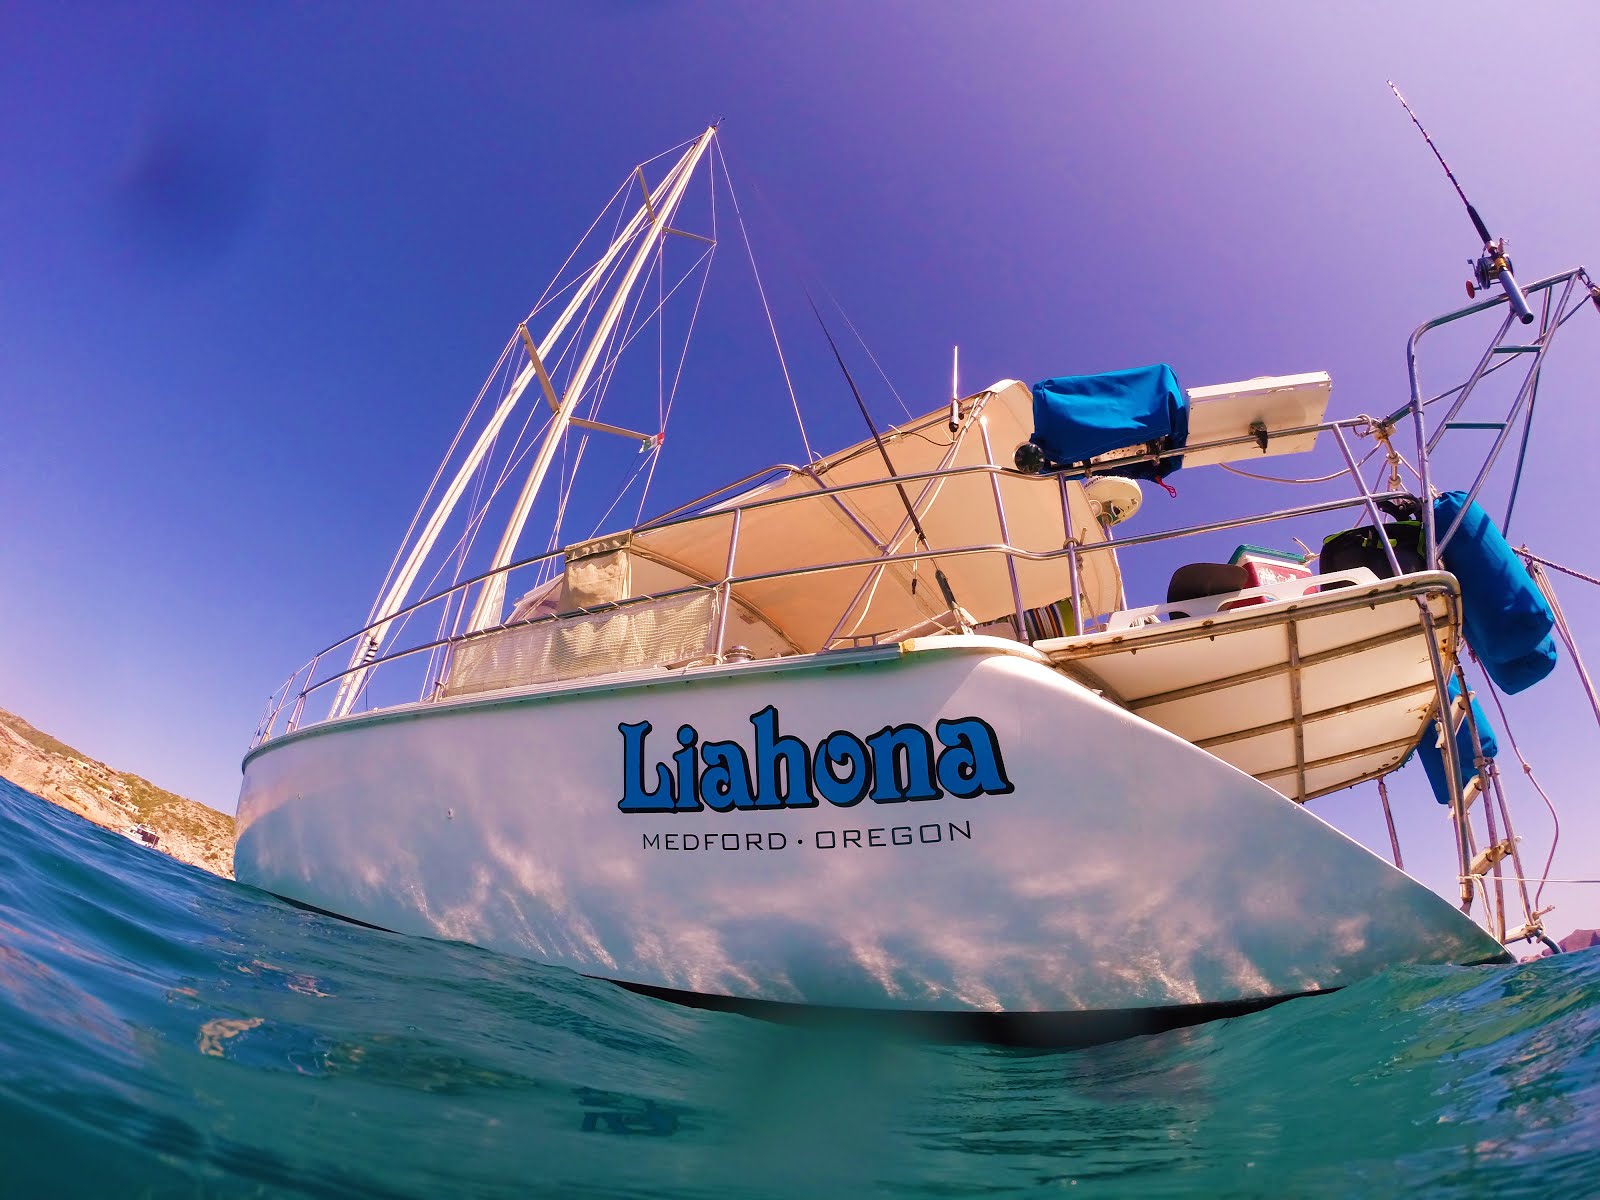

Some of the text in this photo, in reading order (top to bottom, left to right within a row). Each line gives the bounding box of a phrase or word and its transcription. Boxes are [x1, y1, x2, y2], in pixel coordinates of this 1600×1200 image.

[618, 705, 1015, 813] Liahona
[643, 820, 972, 850] MEDFORD OREGON
